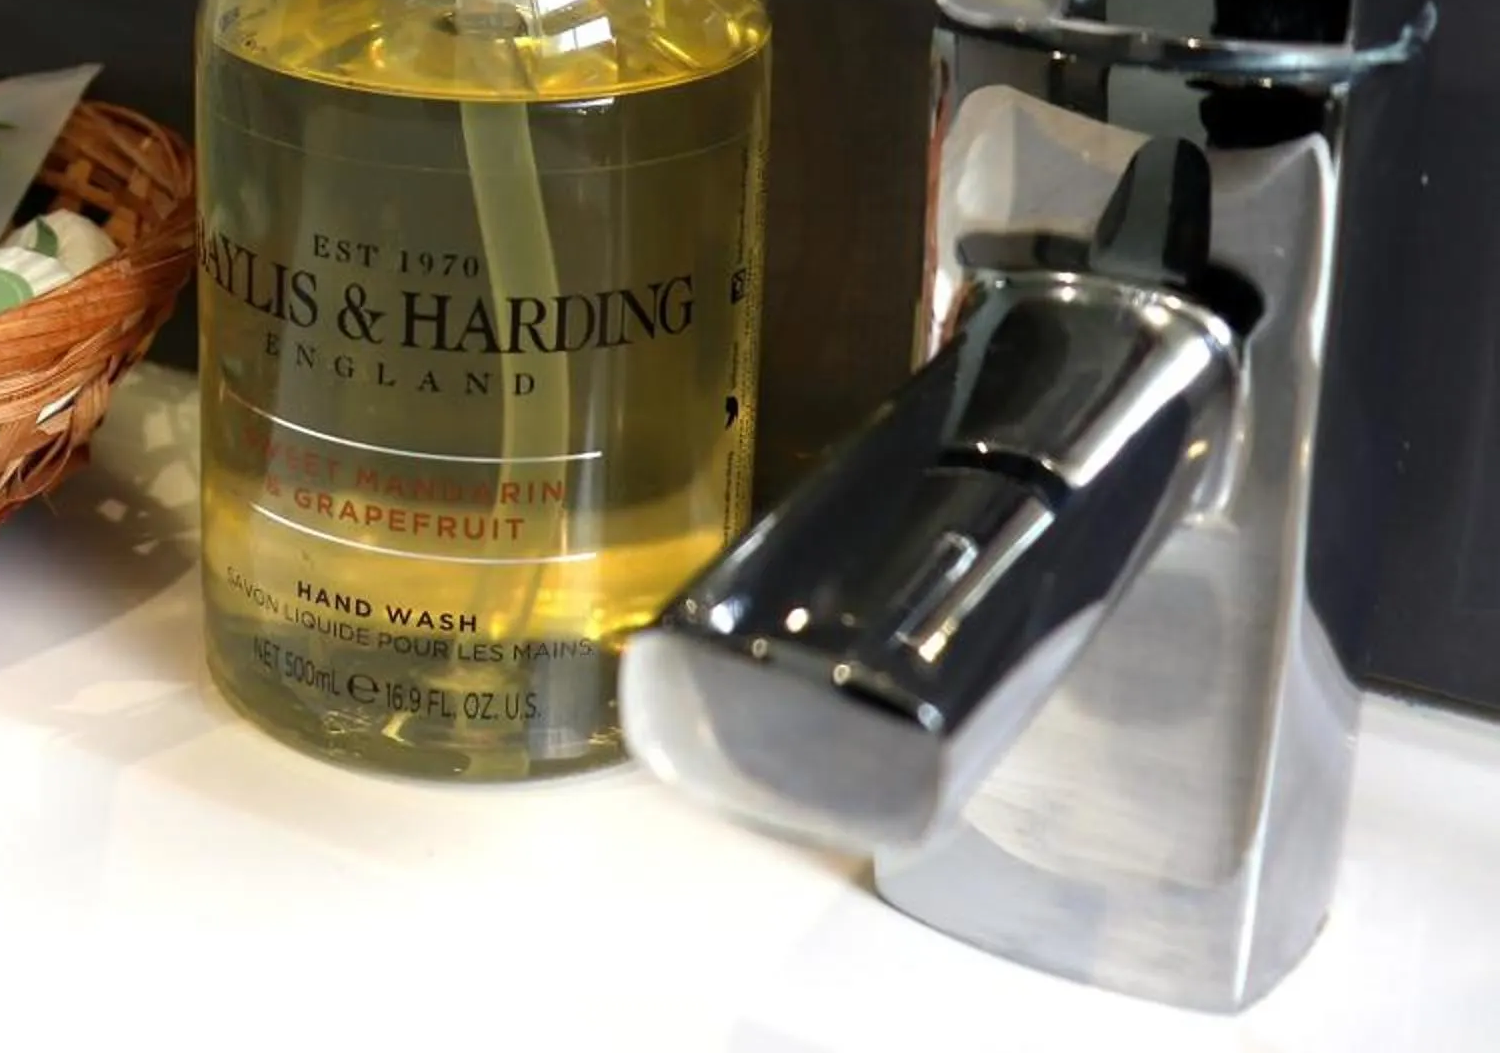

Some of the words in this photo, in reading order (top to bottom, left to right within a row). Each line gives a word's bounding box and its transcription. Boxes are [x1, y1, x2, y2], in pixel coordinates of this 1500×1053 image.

[313, 234, 379, 268] EST
[401, 252, 480, 279] 1970
[337, 282, 387, 344] &
[402, 275, 697, 354] HARDING
[265, 331, 536, 397] ENGLAND
[293, 488, 526, 541] GRAPEFRUIT
[356, 468, 565, 505] MANDARIN
[226, 565, 280, 614] SAVON
[284, 603, 371, 646] LIQUIDE
[378, 631, 451, 660] POUR
[457, 643, 504, 663] LES
[297, 580, 373, 618] HAND
[386, 604, 477, 633] WASH
[253, 635, 280, 667] NET
[284, 651, 340, 696] 500mL
[386, 682, 422, 713] 16.9
